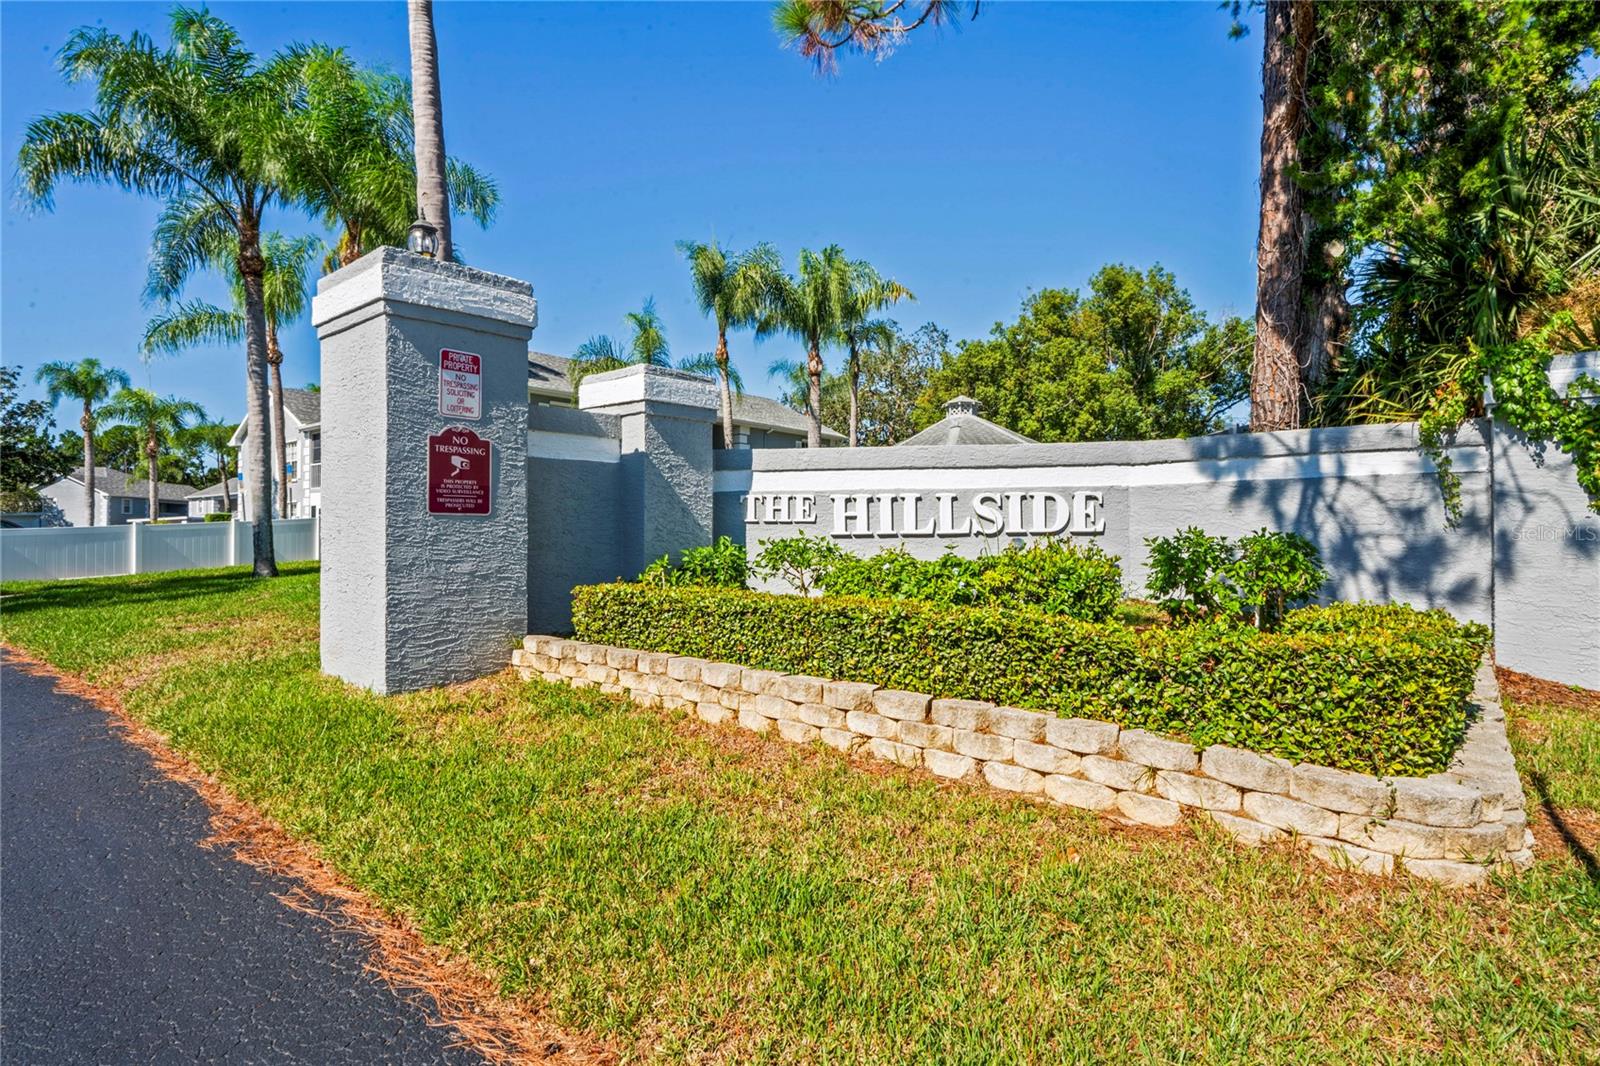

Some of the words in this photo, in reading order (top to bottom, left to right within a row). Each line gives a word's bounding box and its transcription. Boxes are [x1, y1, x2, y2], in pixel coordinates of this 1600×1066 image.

[448, 352, 474, 364] PRIVATE
[443, 360, 478, 373] PROPERTY
[455, 373, 467, 381] NO
[443, 379, 478, 391] TRESPASSING
[446, 388, 475, 398] SOLICITING
[446, 404, 474, 414] LOITERING
[452, 436, 469, 445] NO
[435, 444, 486, 456] TRESPASSING
[740, 493, 817, 525] THE
[830, 490, 1105, 538] HILLSIDE
